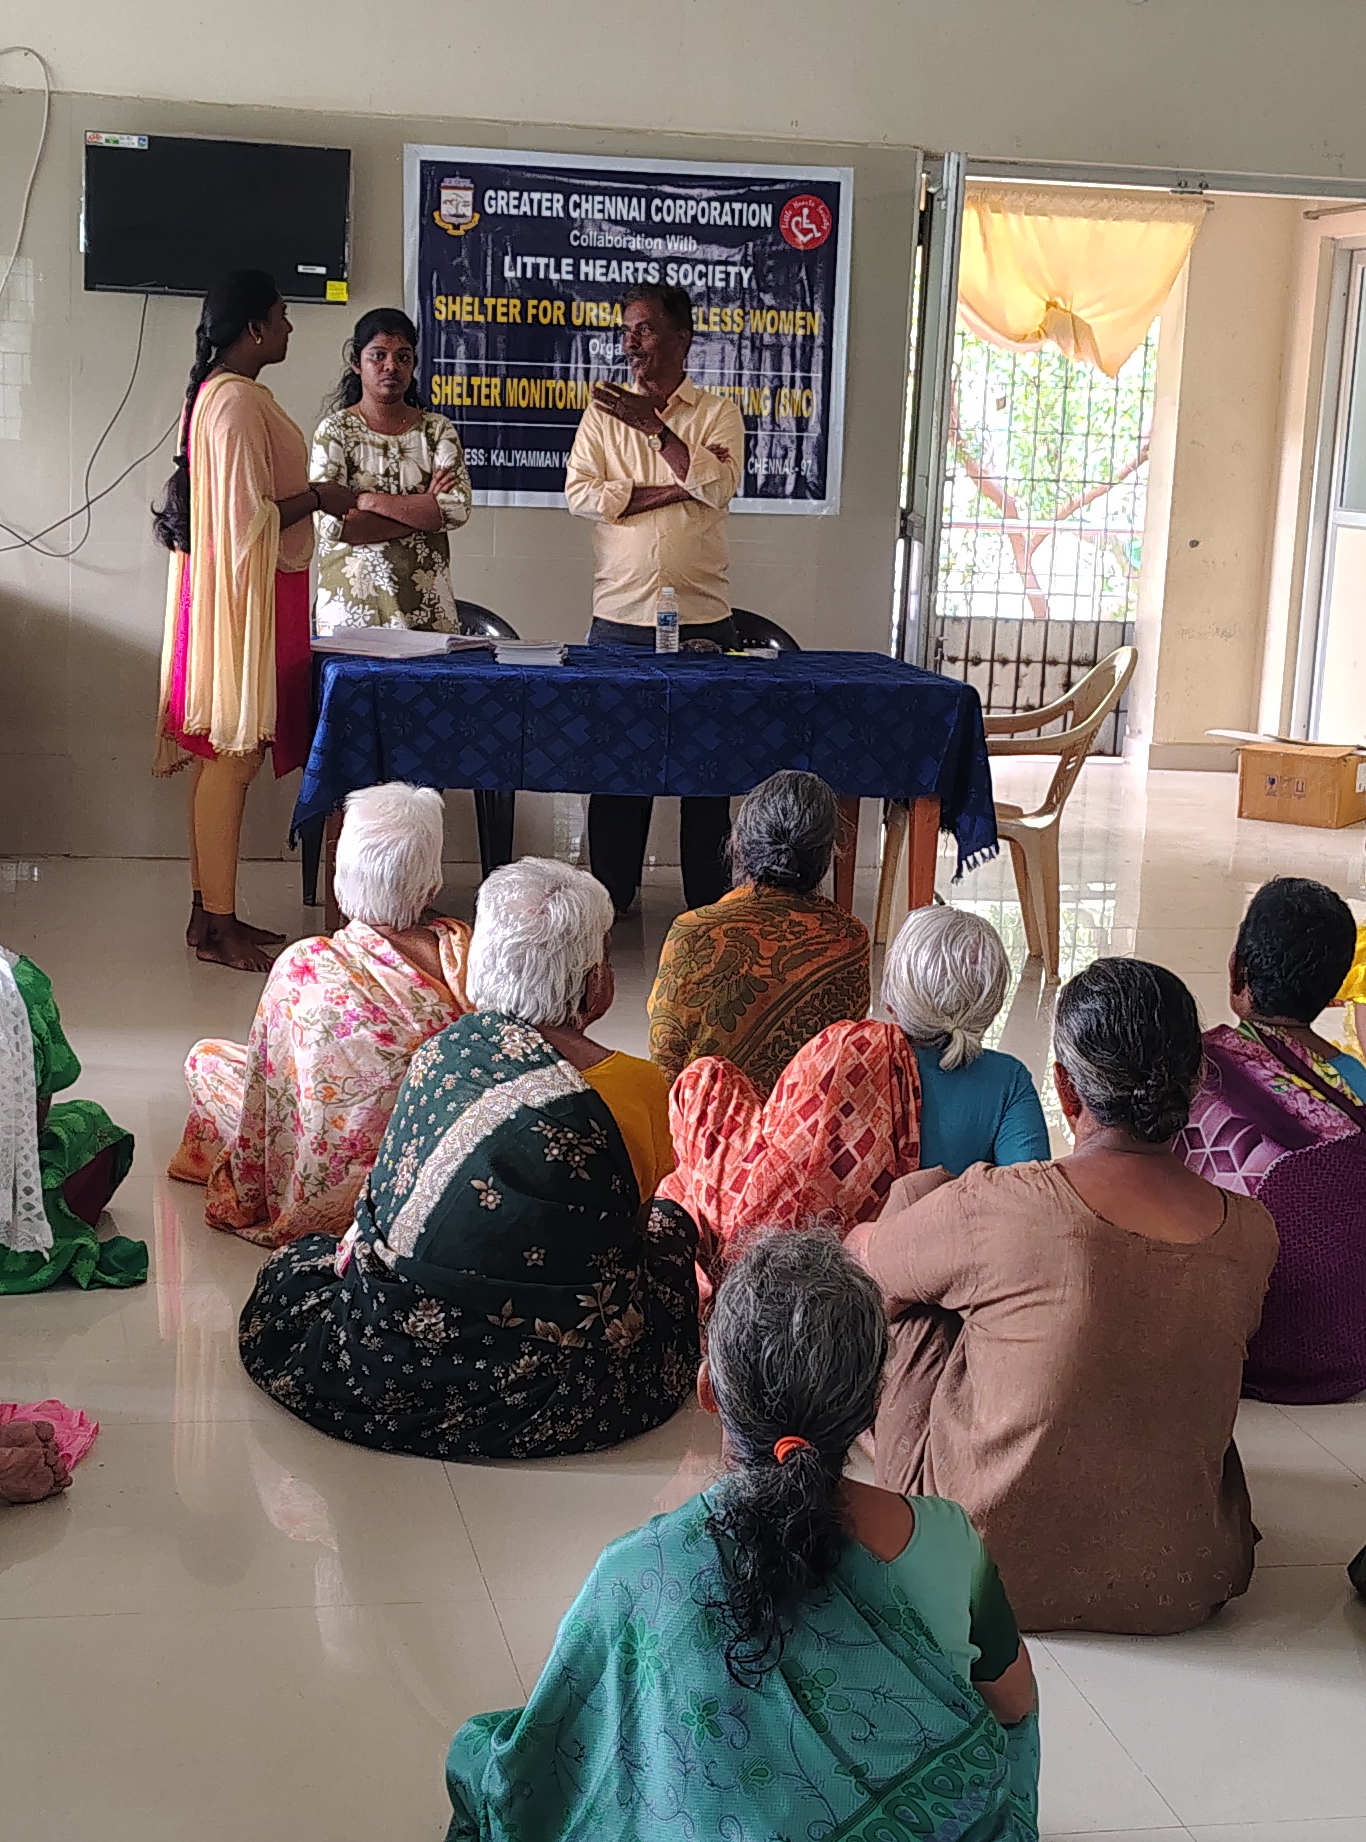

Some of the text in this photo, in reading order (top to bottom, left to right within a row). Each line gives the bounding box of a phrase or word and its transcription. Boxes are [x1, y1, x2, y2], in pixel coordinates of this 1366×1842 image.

[483, 189, 773, 228] GREATER CHENNAI CORPORATION
[569, 229, 697, 252] Collaboration With
[503, 255, 753, 289] LITTLE HEARTS SOCIETY
[434, 294, 521, 324] SHELTER
[527, 298, 566, 326] FOR
[571, 300, 623, 328] URBA
[749, 308, 821, 336] WOMEN
[430, 374, 502, 408] SHELTER
[505, 377, 595, 411] MONITORIN
[774, 387, 817, 426] (SMC)
[464, 447, 488, 466] ESS:
[490, 448, 560, 469] KALIYAMMAN
